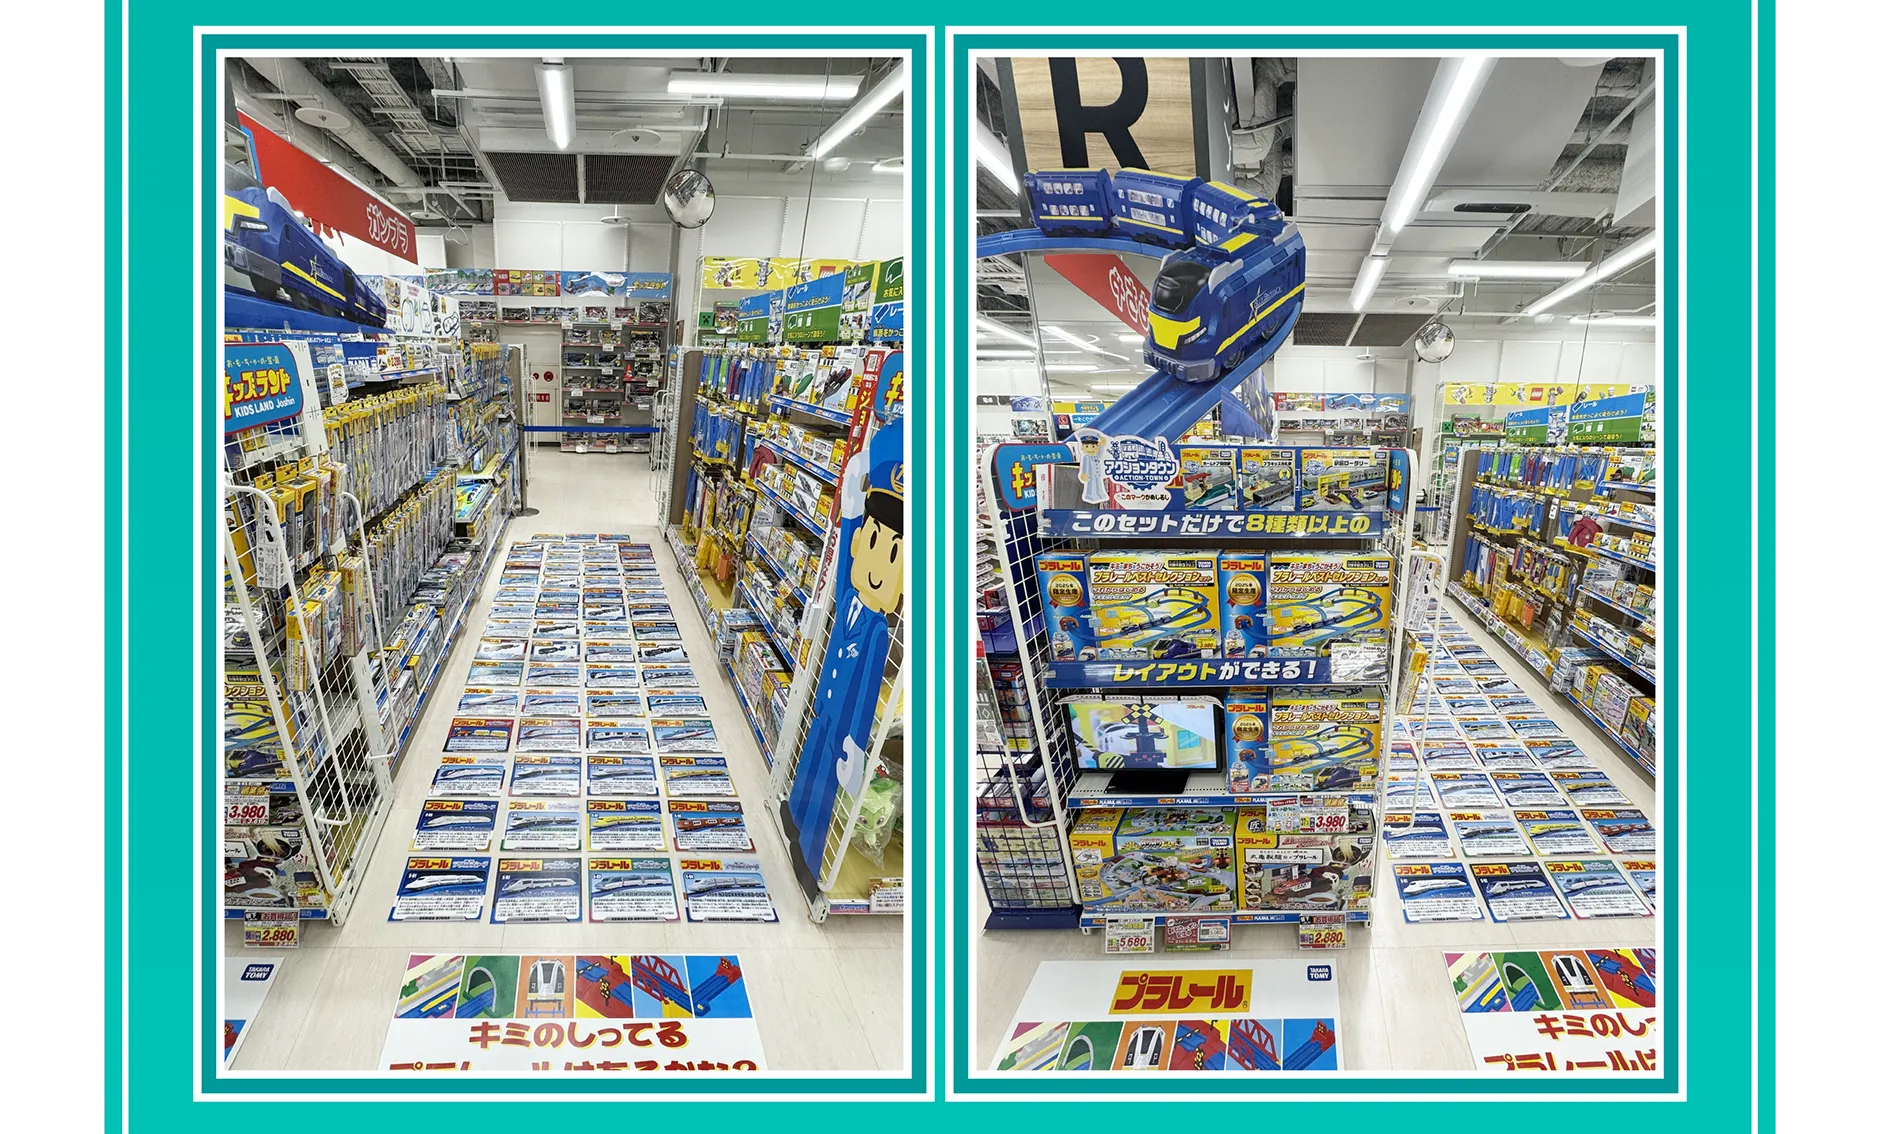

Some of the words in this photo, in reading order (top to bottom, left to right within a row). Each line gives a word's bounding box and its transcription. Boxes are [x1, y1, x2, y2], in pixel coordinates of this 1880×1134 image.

[1048, 57, 1151, 169] R
[367, 203, 409, 255] ガンプラ
[234, 405, 254, 418] KIDS
[254, 400, 275, 414] LAND
[276, 396, 295, 409] Joshin
[1104, 459, 1176, 475] アクションタウン
[1072, 513, 1370, 533] このセットだけで8種類以上の
[1039, 561, 1082, 571] プラレール
[1222, 561, 1263, 570] プラレール
[1228, 704, 1266, 712] プラレール
[426, 801, 461, 810] プラレール
[509, 801, 544, 810] プラレール
[589, 802, 623, 810] プラレール
[671, 802, 706, 811] プラレール
[229, 805, 266, 818] 3,980
[1516, 811, 1547, 819] プラレール
[1583, 810, 1614, 818] プラレール
[1316, 816, 1346, 828] 3,980
[1450, 813, 1482, 821] プラレール
[1238, 837, 1270, 845] プラレール
[409, 858, 449, 869] プラレール
[501, 861, 540, 871] プラレール
[590, 860, 630, 870] プラレール
[680, 860, 721, 870] プラレール
[1547, 862, 1583, 872] プラレール
[1395, 865, 1430, 875] プラレール
[1473, 865, 1508, 875] プラレール
[262, 929, 295, 941] 2,880
[1314, 932, 1343, 943] 2,880
[1114, 972, 1244, 1010] プラレール
[468, 1020, 688, 1049] キミのしってる
